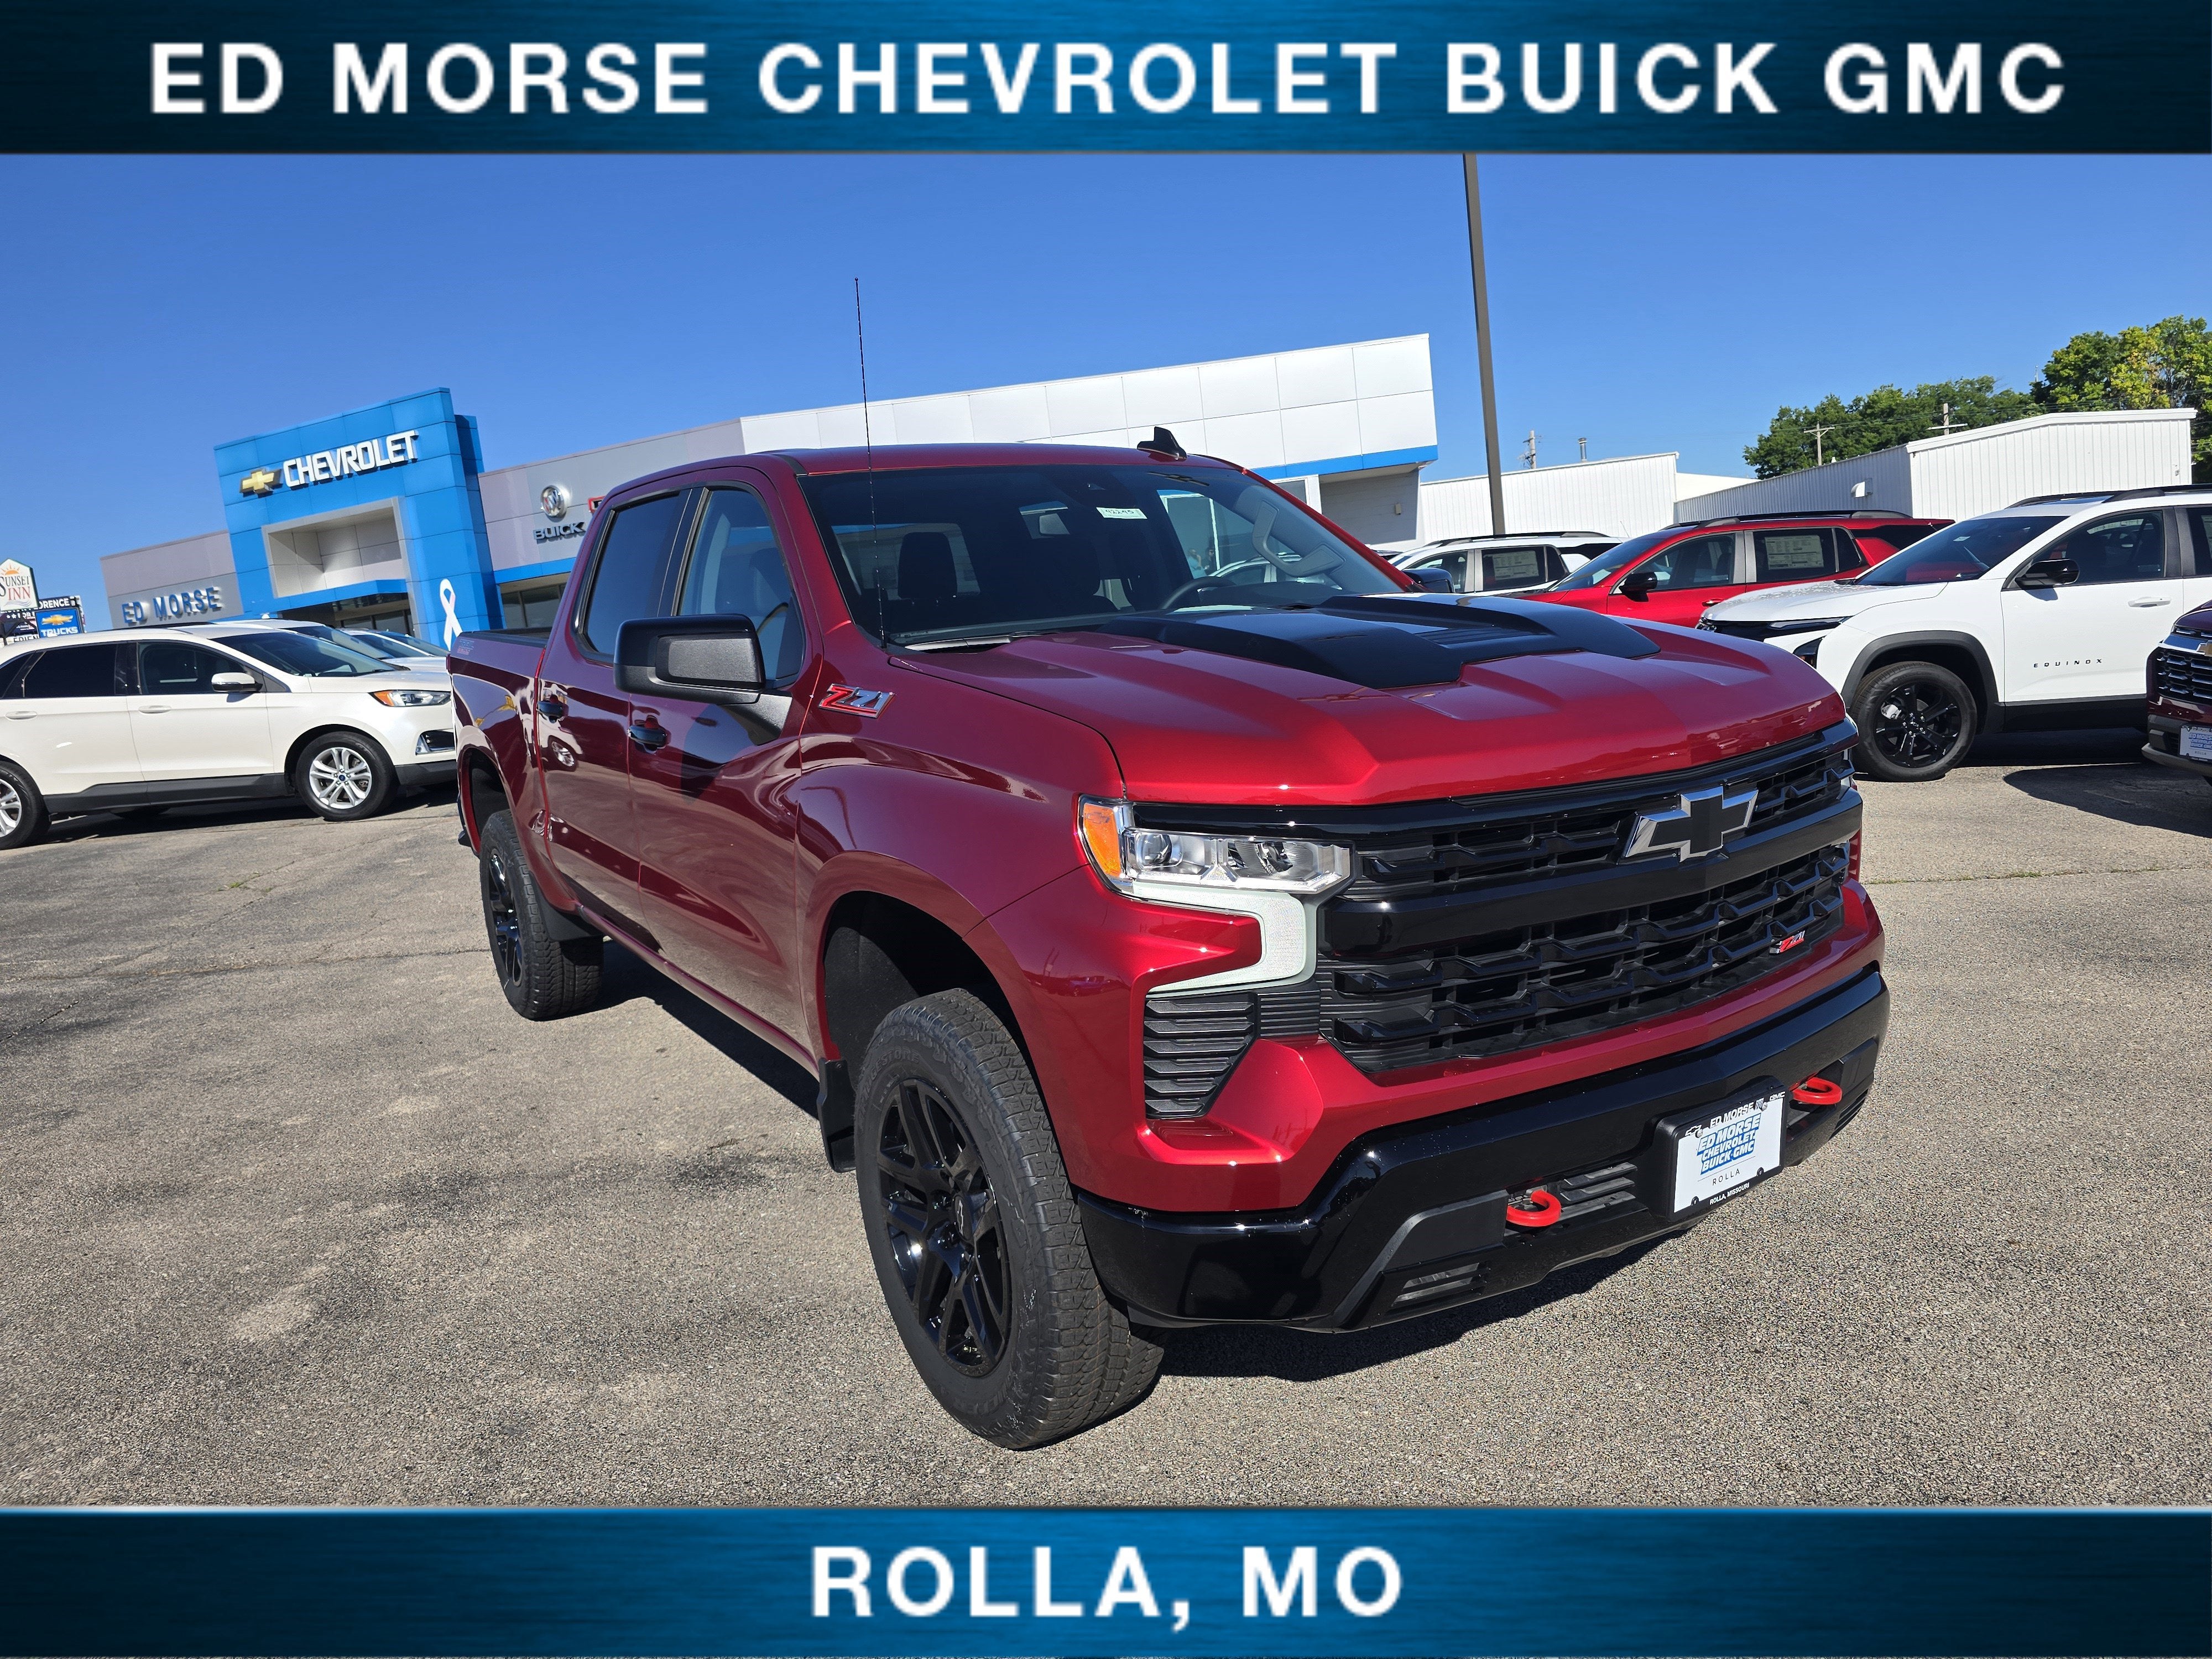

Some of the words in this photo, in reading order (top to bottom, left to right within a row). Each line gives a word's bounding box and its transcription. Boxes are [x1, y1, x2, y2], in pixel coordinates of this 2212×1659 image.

[283, 430, 417, 488] CHEVROLET
[533, 521, 584, 540] BUICK
[8, 586, 31, 601] INN
[122, 601, 147, 624] ED
[153, 586, 221, 618] MORSE
[41, 626, 78, 638] TRUCKS
[2033, 659, 2101, 668] EQUINOX
[1710, 1115, 1722, 1129] ED
[1723, 1102, 1755, 1123] MORSE
[1769, 1091, 1786, 1102] GMC
[1698, 1132, 1717, 1153] ED
[1715, 1112, 1761, 1144] MORSE
[1701, 1150, 1732, 1174] BUICK
[1733, 1140, 1755, 1159] GMC
[1712, 1168, 1740, 1186] ROLLA
[1709, 1193, 1726, 1206] ROLLA,
[1726, 1182, 1750, 1198] MISSOURI
